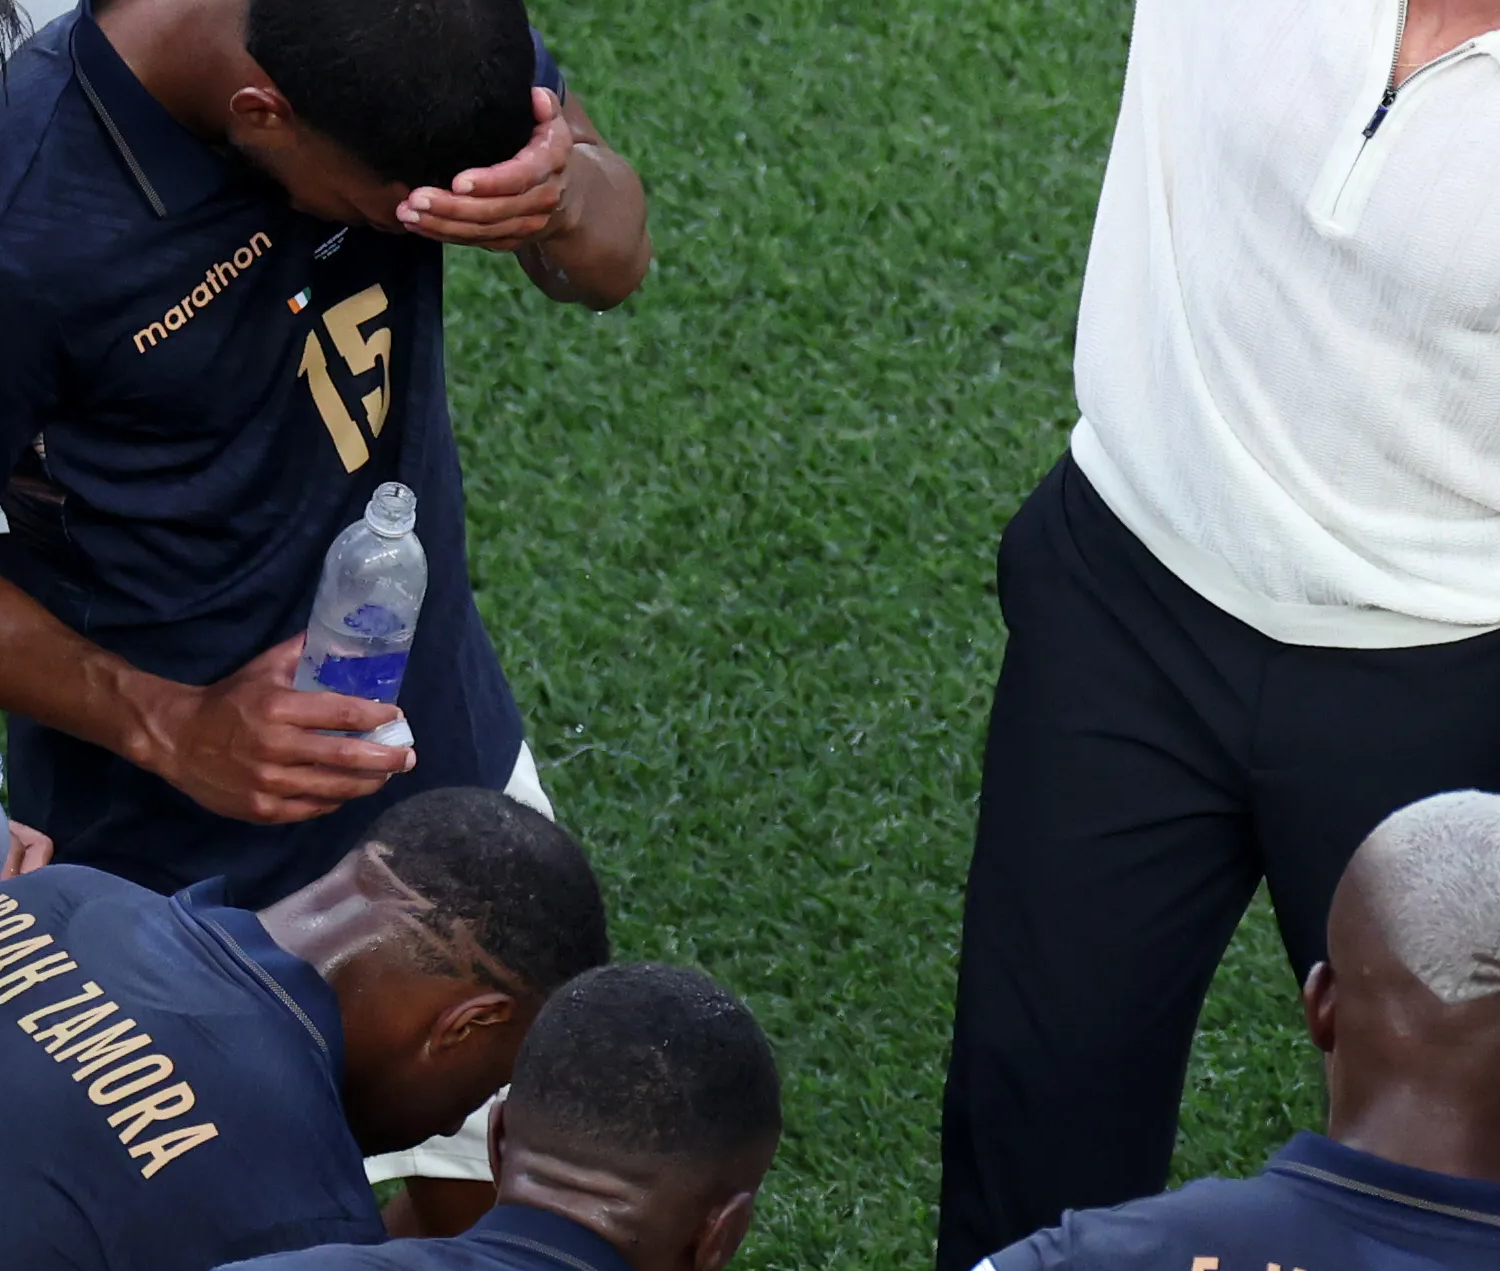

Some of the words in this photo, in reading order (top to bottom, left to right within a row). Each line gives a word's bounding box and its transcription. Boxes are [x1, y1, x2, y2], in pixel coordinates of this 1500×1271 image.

[133, 231, 273, 354] marathon
[297, 282, 393, 474] 15
[17, 981, 219, 1179] ZAMORA
